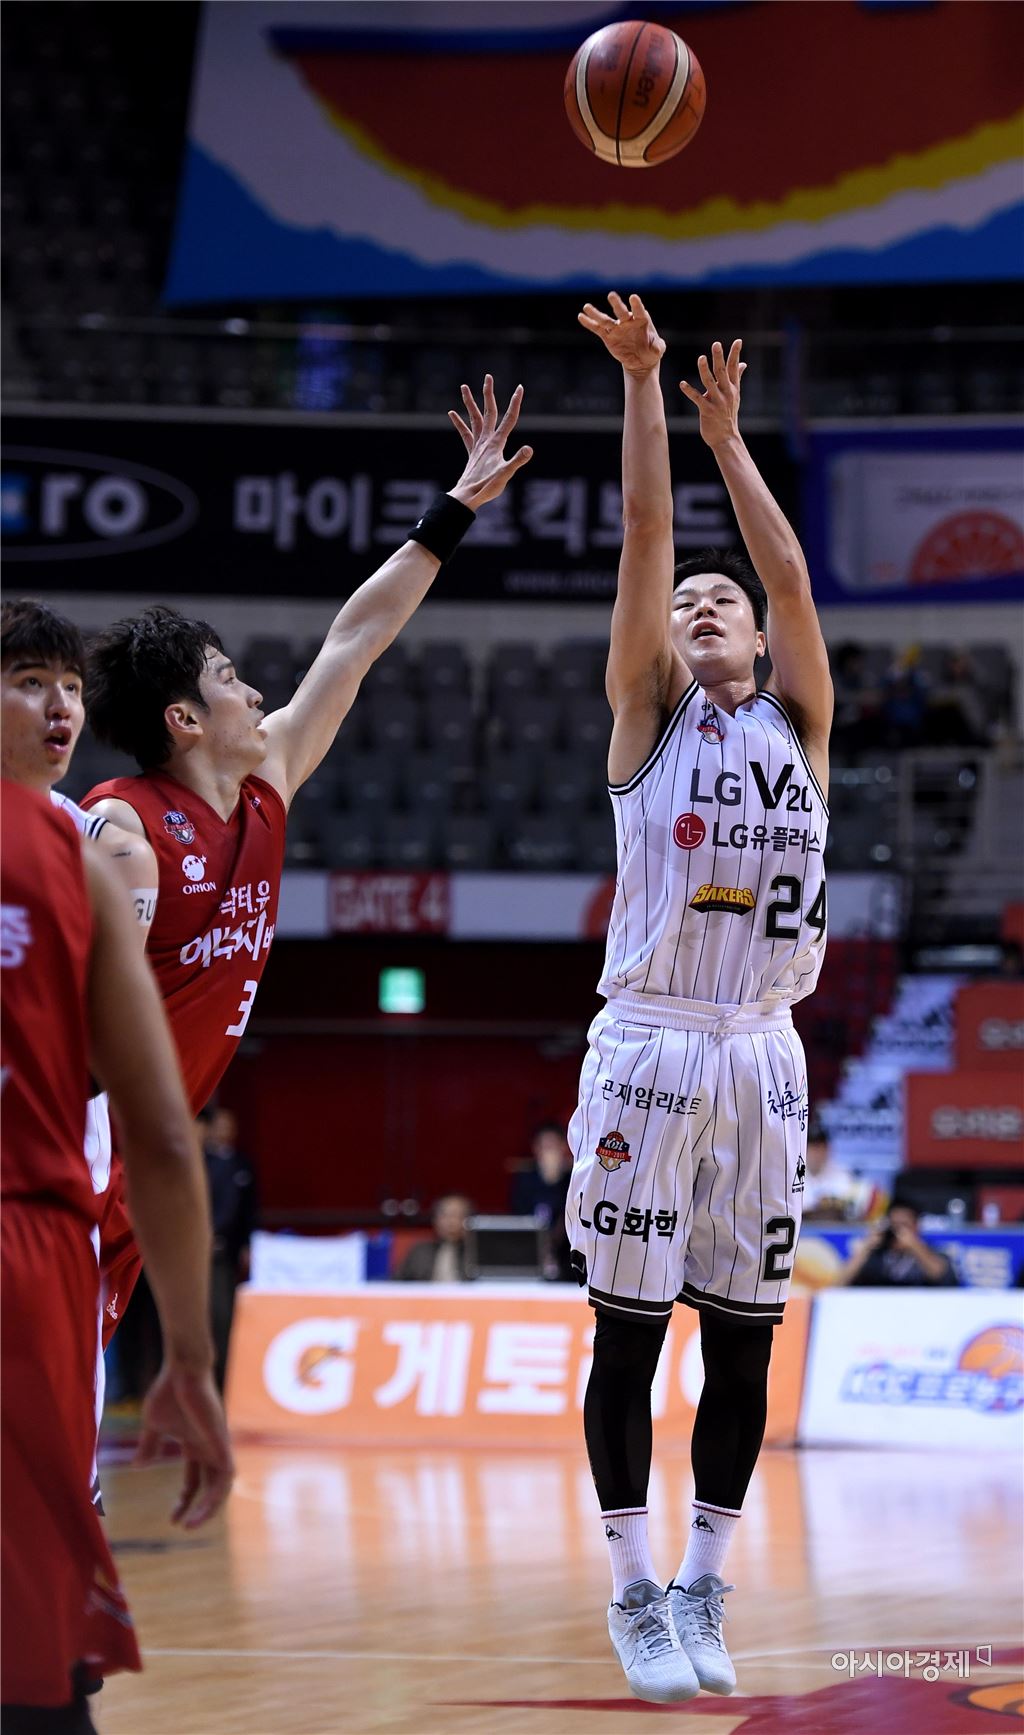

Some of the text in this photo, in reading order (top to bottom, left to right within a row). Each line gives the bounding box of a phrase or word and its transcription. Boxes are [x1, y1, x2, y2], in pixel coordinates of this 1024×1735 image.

[690, 768, 742, 807] LG
[712, 822, 820, 853] LG유플러스
[182, 881, 217, 895] ORION
[334, 874, 446, 930] GATE 4
[691, 884, 755, 907] SAKERS
[601, 1078, 702, 1117] 곤지암리조트
